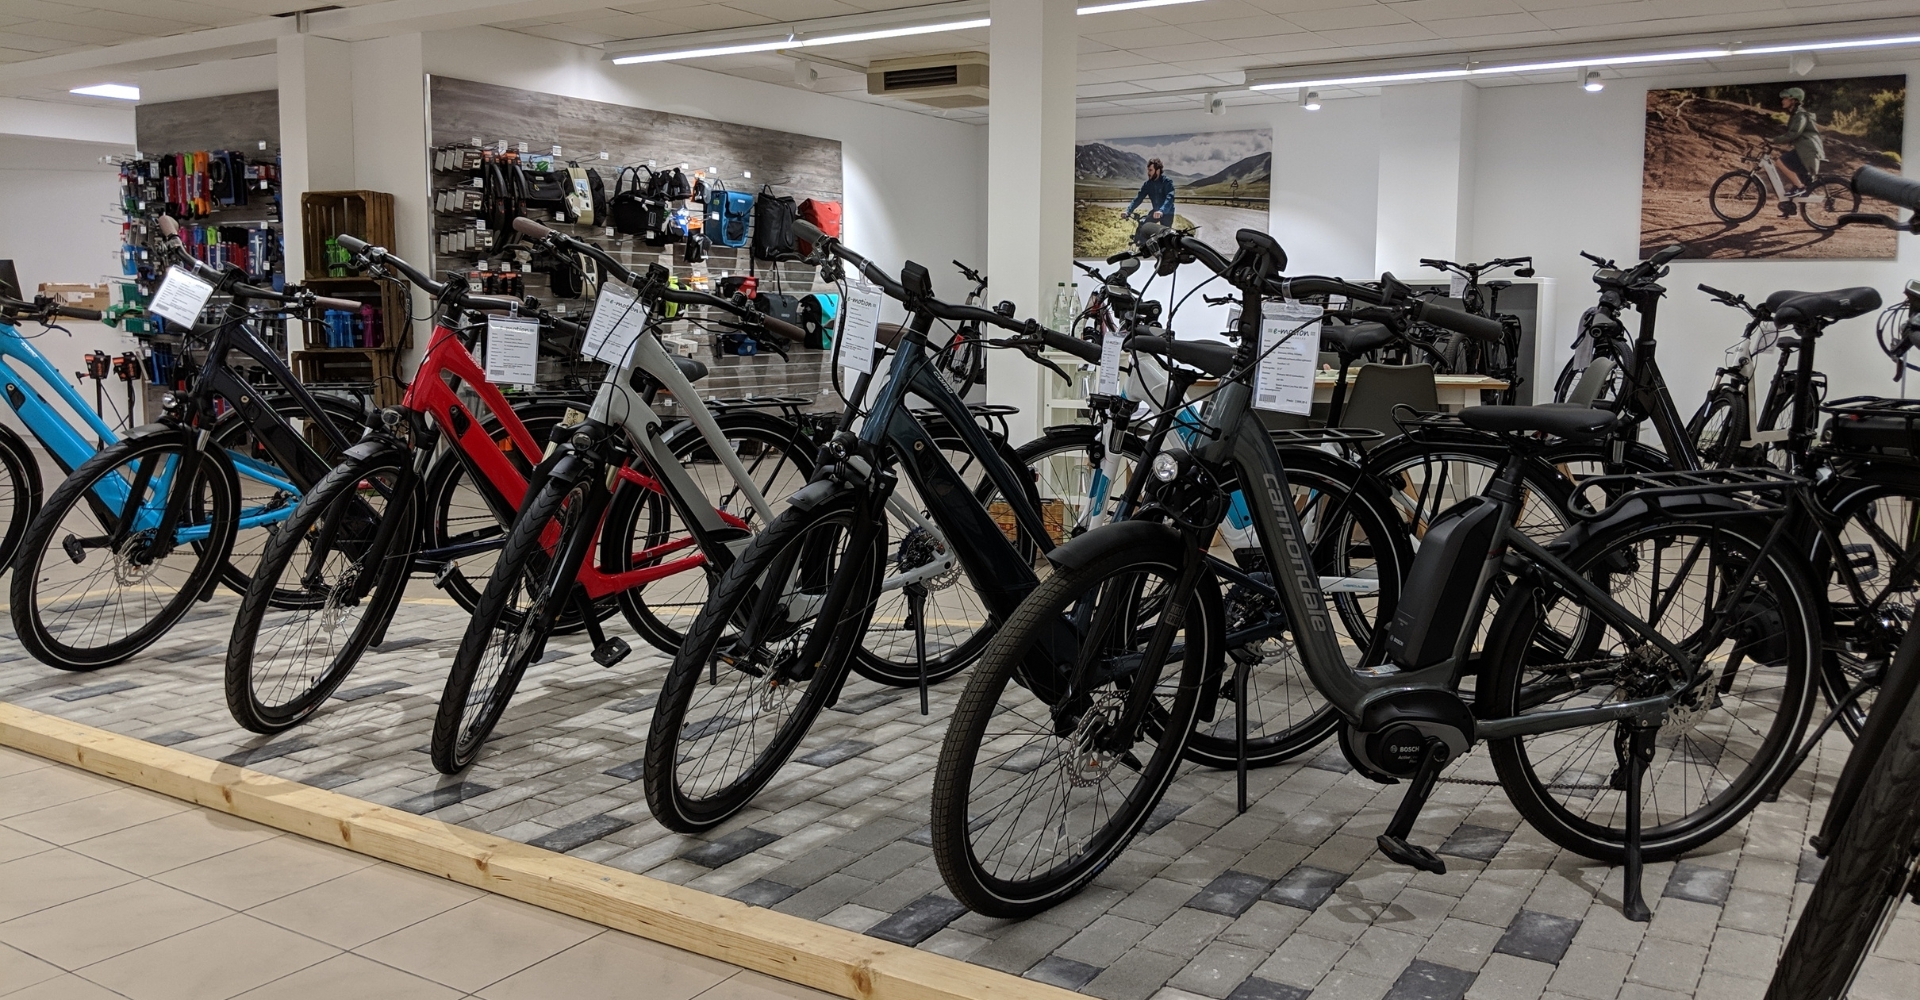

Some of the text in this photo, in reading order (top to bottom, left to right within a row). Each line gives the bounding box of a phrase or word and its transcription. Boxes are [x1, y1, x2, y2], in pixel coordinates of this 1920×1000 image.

[609, 299, 639, 314] e-moton
[1273, 327, 1310, 337] e-moion
[1262, 472, 1327, 632] cannondale
[1399, 745, 1420, 753] BOSCH
